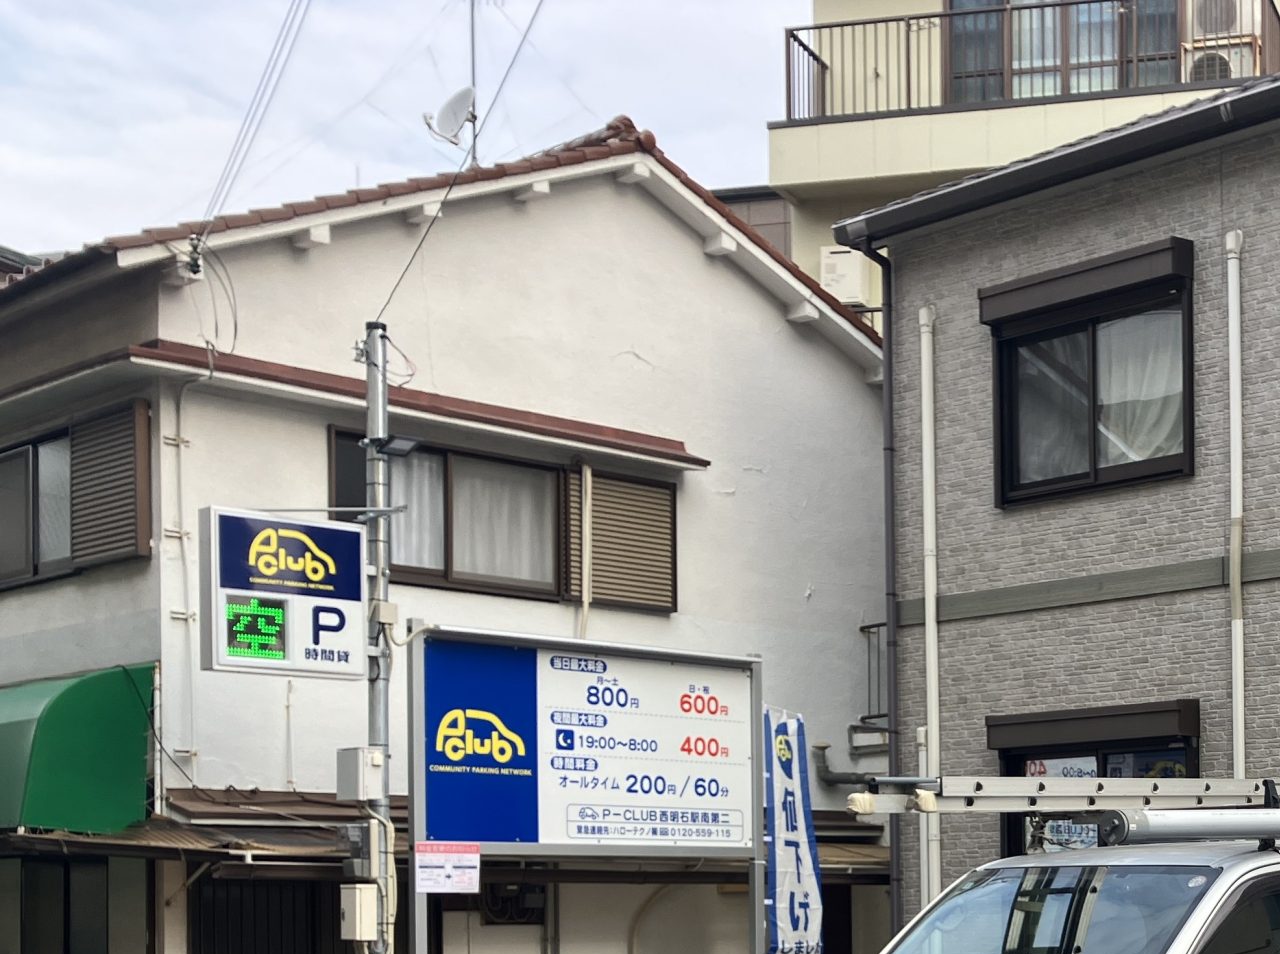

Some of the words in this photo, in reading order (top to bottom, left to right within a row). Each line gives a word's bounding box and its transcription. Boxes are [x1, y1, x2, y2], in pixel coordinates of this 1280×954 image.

[225, 598, 285, 660] 空
[312, 605, 346, 646] P
[304, 647, 350, 664] 時間貸
[552, 656, 605, 673] 当日最大料金
[586, 685, 640, 709] 800円
[679, 693, 729, 716] 600円
[552, 711, 605, 728] 夜間最大料金
[679, 736, 729, 758] 400円
[429, 764, 471, 773] COMMUNITY
[471, 766, 500, 775] PARKING
[500, 768, 533, 777] NETWORK
[552, 756, 597, 772] 時間料金
[558, 774, 620, 791] オールタイム
[670, 827, 731, 838] 0120-559-115
